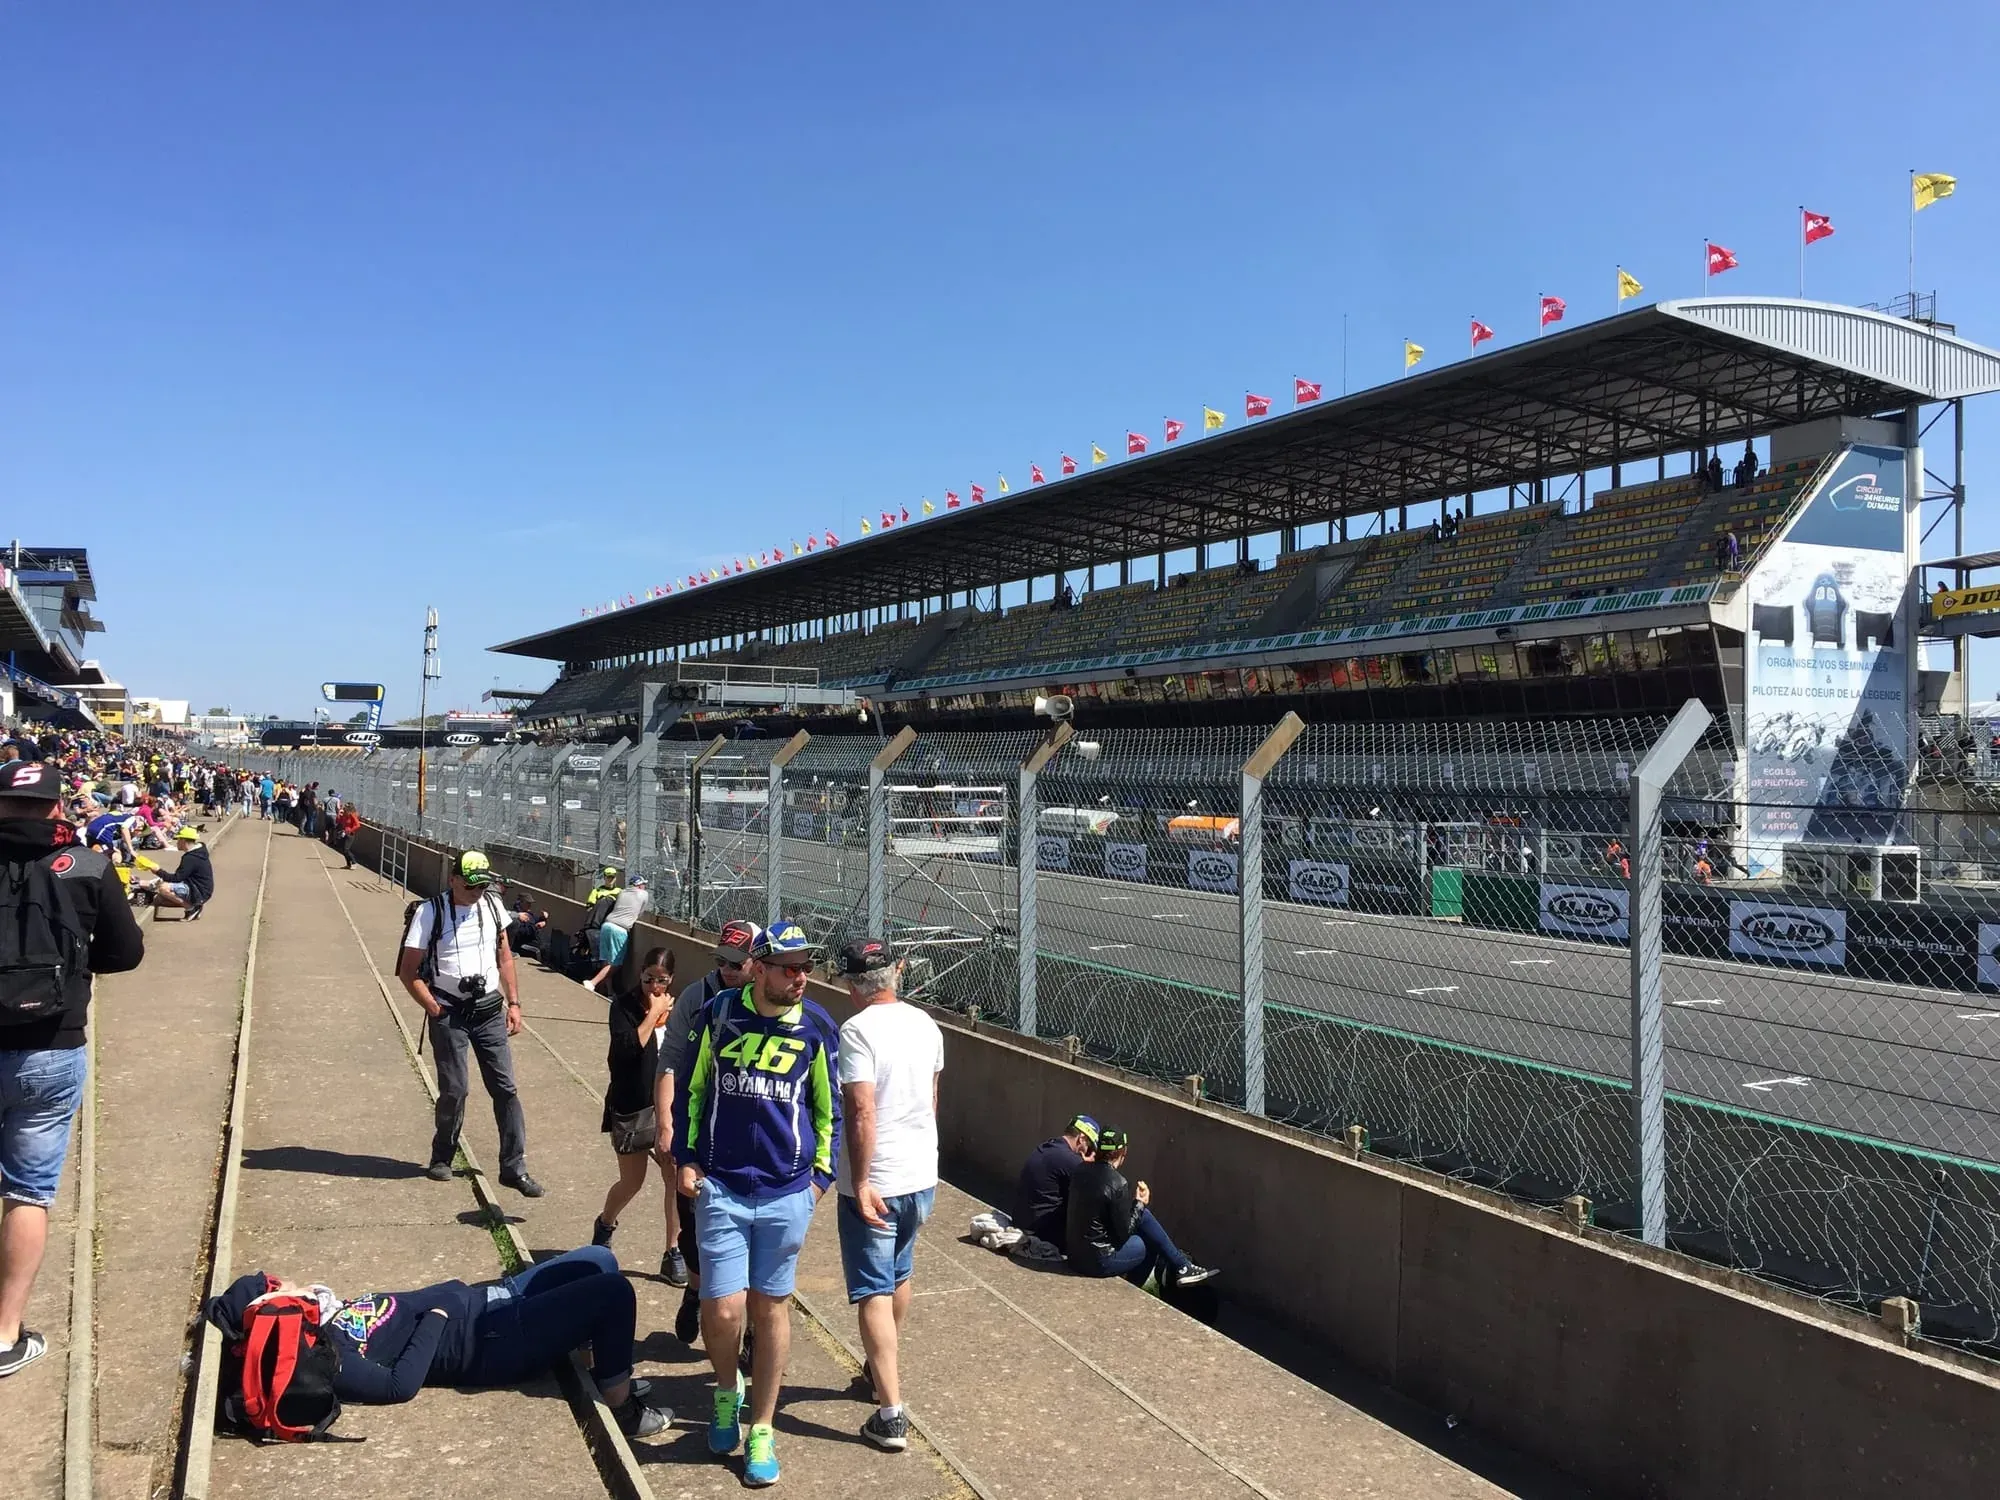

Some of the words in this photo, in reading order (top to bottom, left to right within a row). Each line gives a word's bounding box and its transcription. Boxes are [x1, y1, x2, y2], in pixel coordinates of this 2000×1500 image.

[1856, 485, 1883, 494] CIRCUIT
[1867, 501, 1878, 509] DU
[1877, 503, 1900, 512] MANS
[1873, 495, 1900, 504] HEURES
[1766, 657, 1817, 669] ORGANISEZ
[1819, 660, 1837, 670] VOS
[1838, 661, 1888, 672] SEMINAIRES
[1826, 674, 1832, 684] &
[1752, 686, 1789, 696] PILOTEZ
[1791, 687, 1803, 697] AU
[1805, 687, 1835, 698] COEUR
[1837, 688, 1849, 698] DE
[1850, 689, 1861, 699] LA
[1862, 689, 1902, 701] LEGENDE
[1554, 901, 1611, 919] HJC
[779, 926, 804, 941] 46
[1751, 920, 1824, 943] HJC
[719, 1032, 806, 1074] 46
[737, 1075, 792, 1098] YAMAHA
